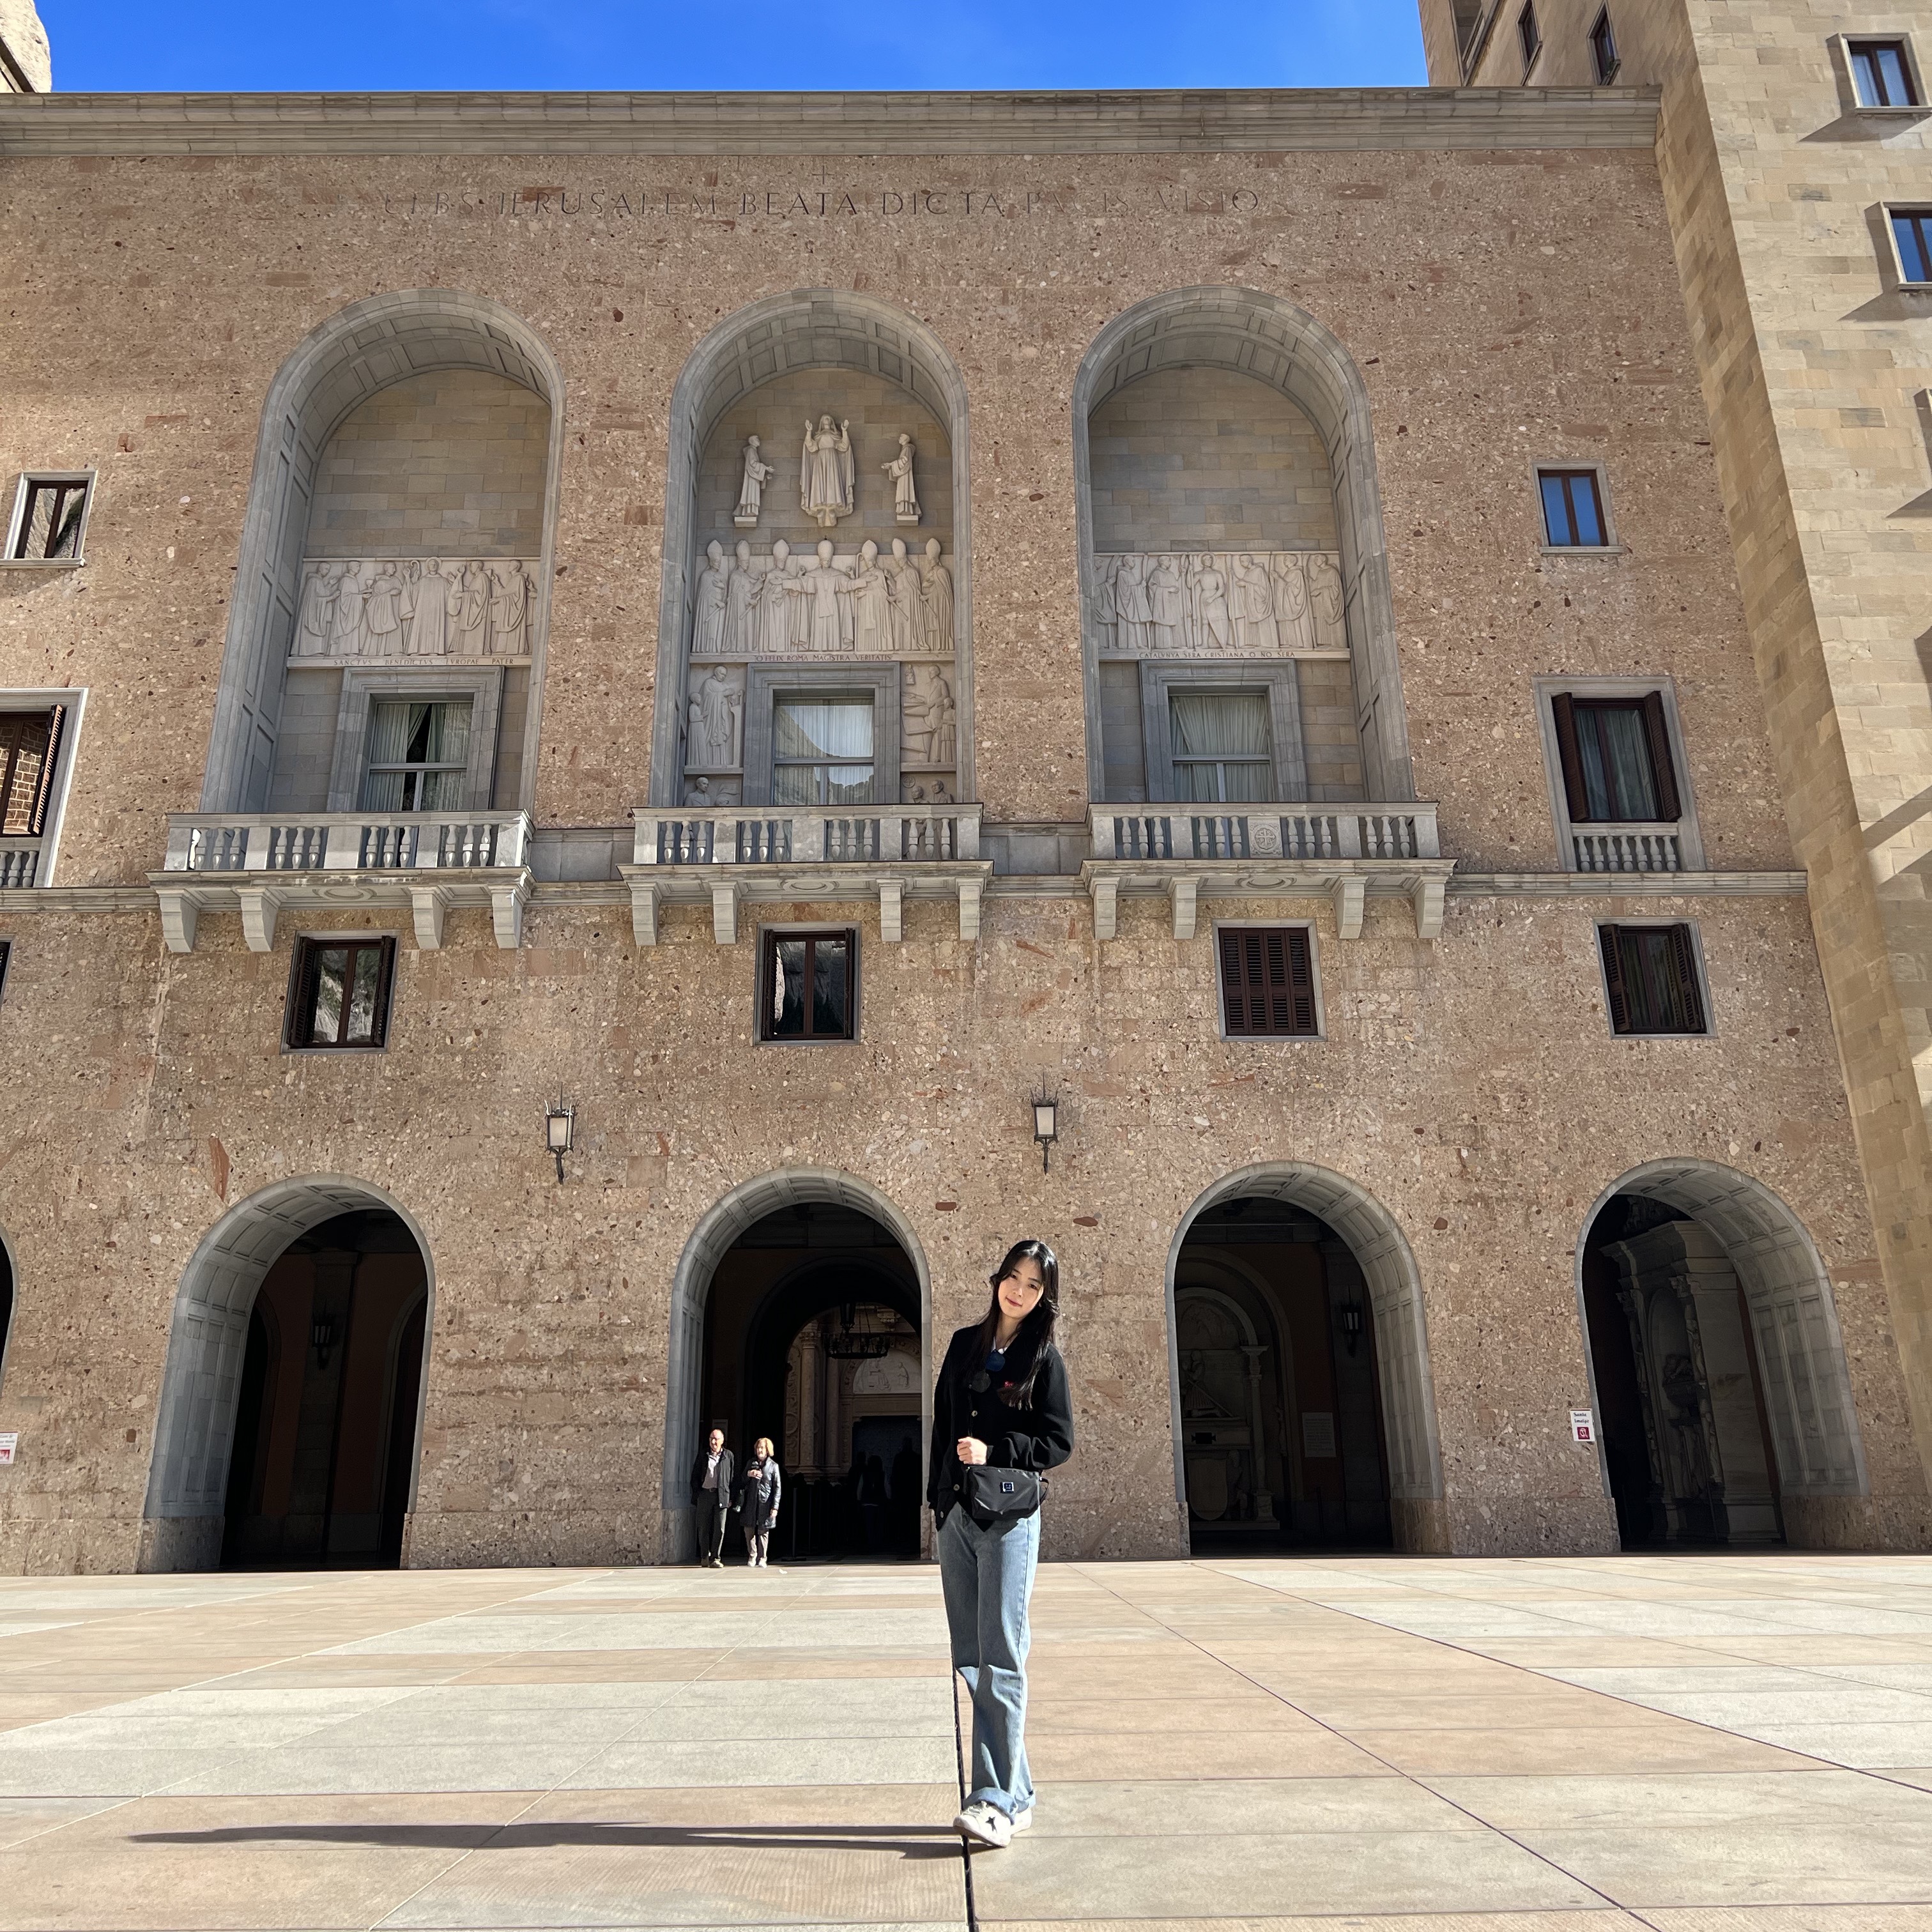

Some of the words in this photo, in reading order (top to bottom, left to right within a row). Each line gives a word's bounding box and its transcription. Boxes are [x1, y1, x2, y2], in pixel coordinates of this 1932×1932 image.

[500, 192, 716, 215] IERUSALEM
[739, 192, 858, 215] BEATA
[882, 192, 1003, 215] DICTA
[1156, 190, 1258, 212] VISIO
